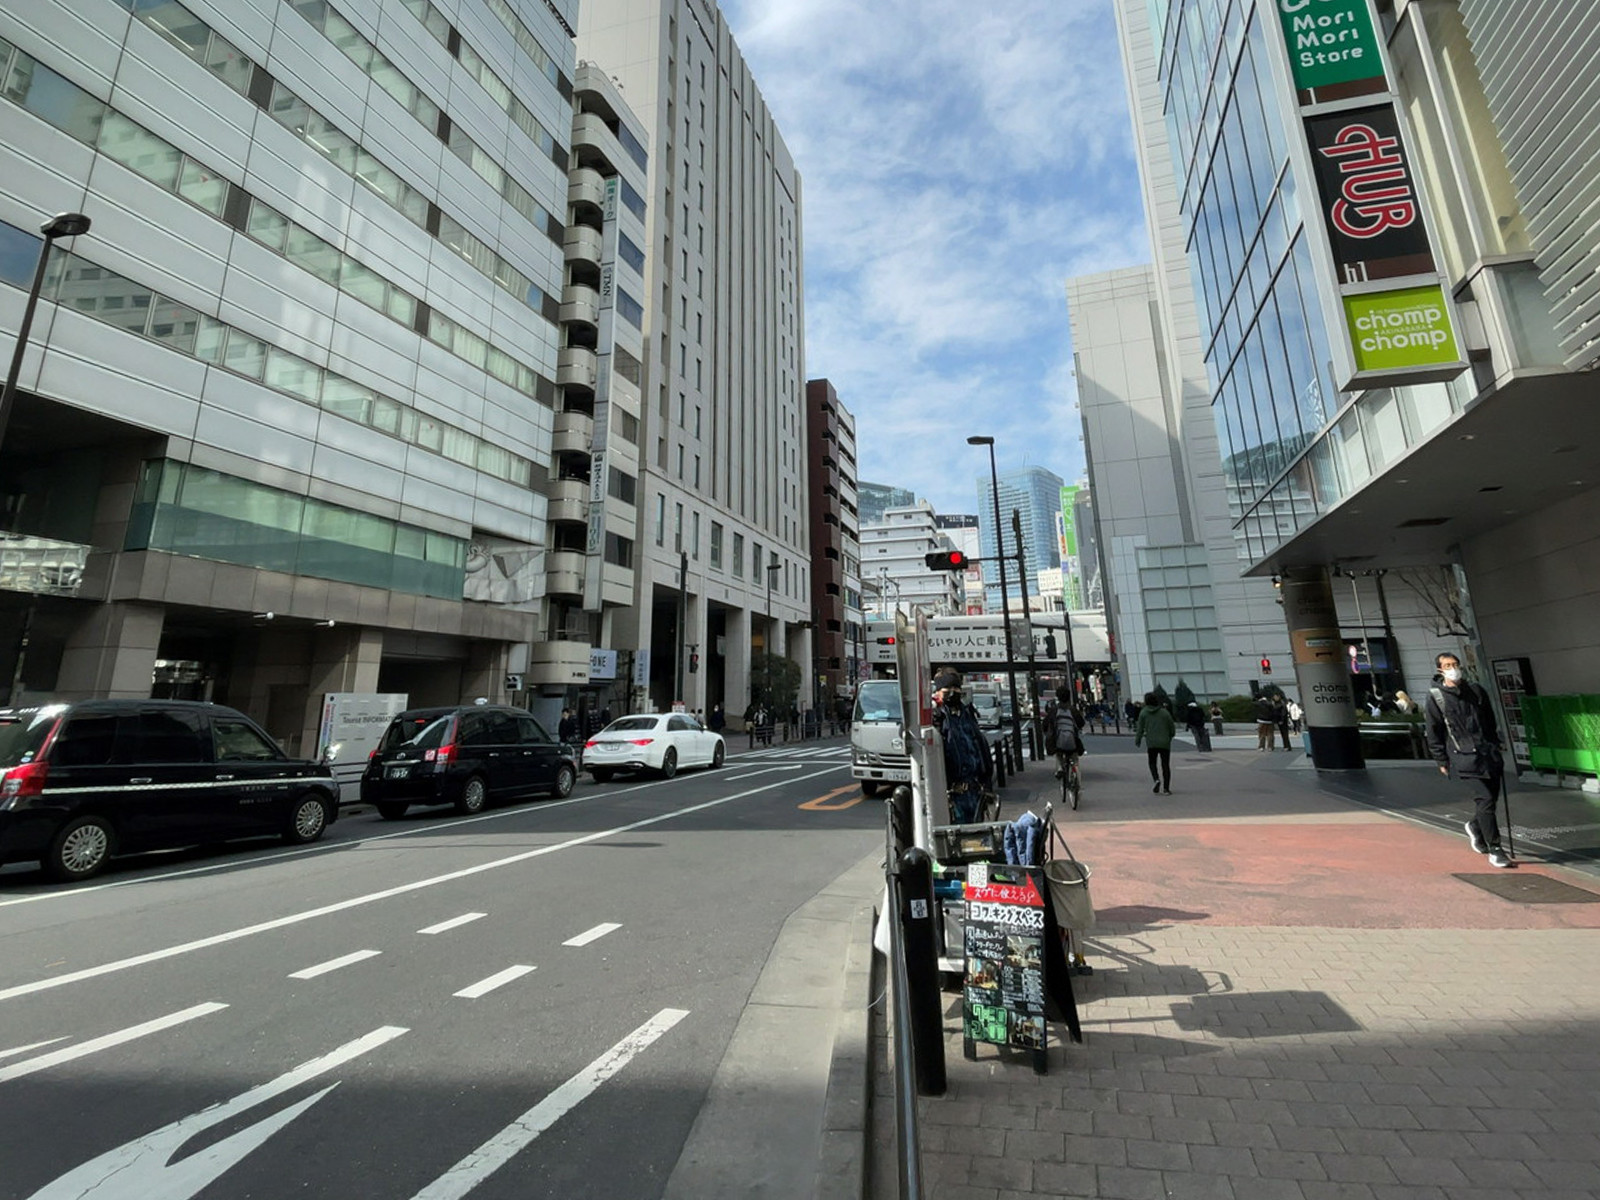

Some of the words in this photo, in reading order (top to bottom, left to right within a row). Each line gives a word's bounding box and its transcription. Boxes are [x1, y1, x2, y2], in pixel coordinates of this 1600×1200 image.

[1293, 11, 1354, 32] Mori
[1297, 28, 1359, 50] Mori
[1300, 47, 1363, 67] Store
[1319, 123, 1416, 239] HUB
[1355, 307, 1441, 331] chomp
[1360, 329, 1447, 351] chomp
